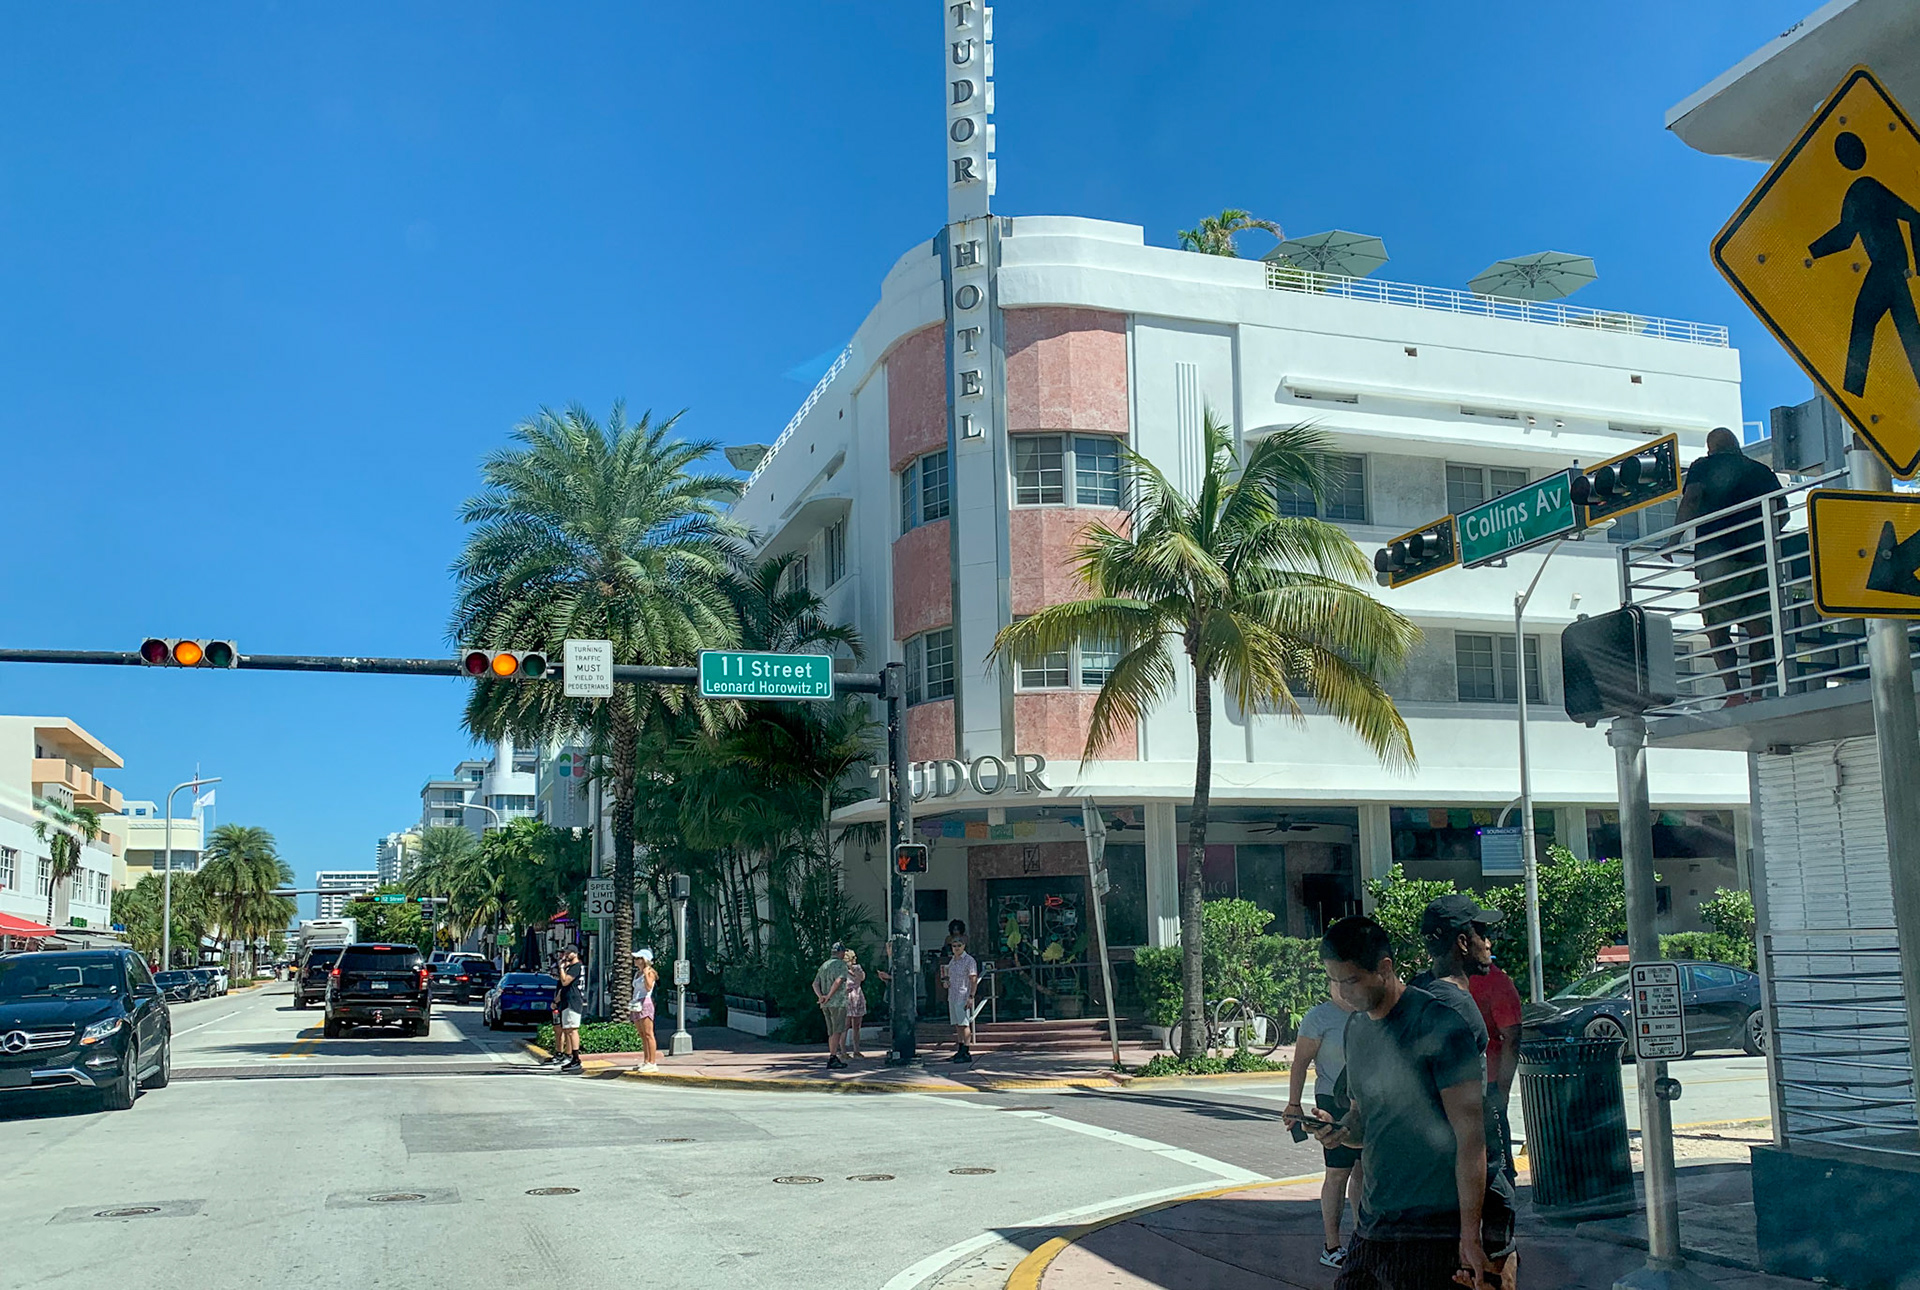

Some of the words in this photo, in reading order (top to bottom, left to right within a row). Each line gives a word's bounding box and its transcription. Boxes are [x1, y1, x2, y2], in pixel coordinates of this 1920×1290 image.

[950, 1, 977, 184] TUDOR
[954, 239, 985, 442] HOTEL
[1466, 502, 1528, 541] Collins
[1536, 488, 1562, 517] Av
[576, 664, 601, 672] MUST
[751, 660, 813, 679] Street
[706, 679, 755, 694] Leonard
[759, 681, 812, 695] Horowitz
[591, 899, 615, 914] 30
